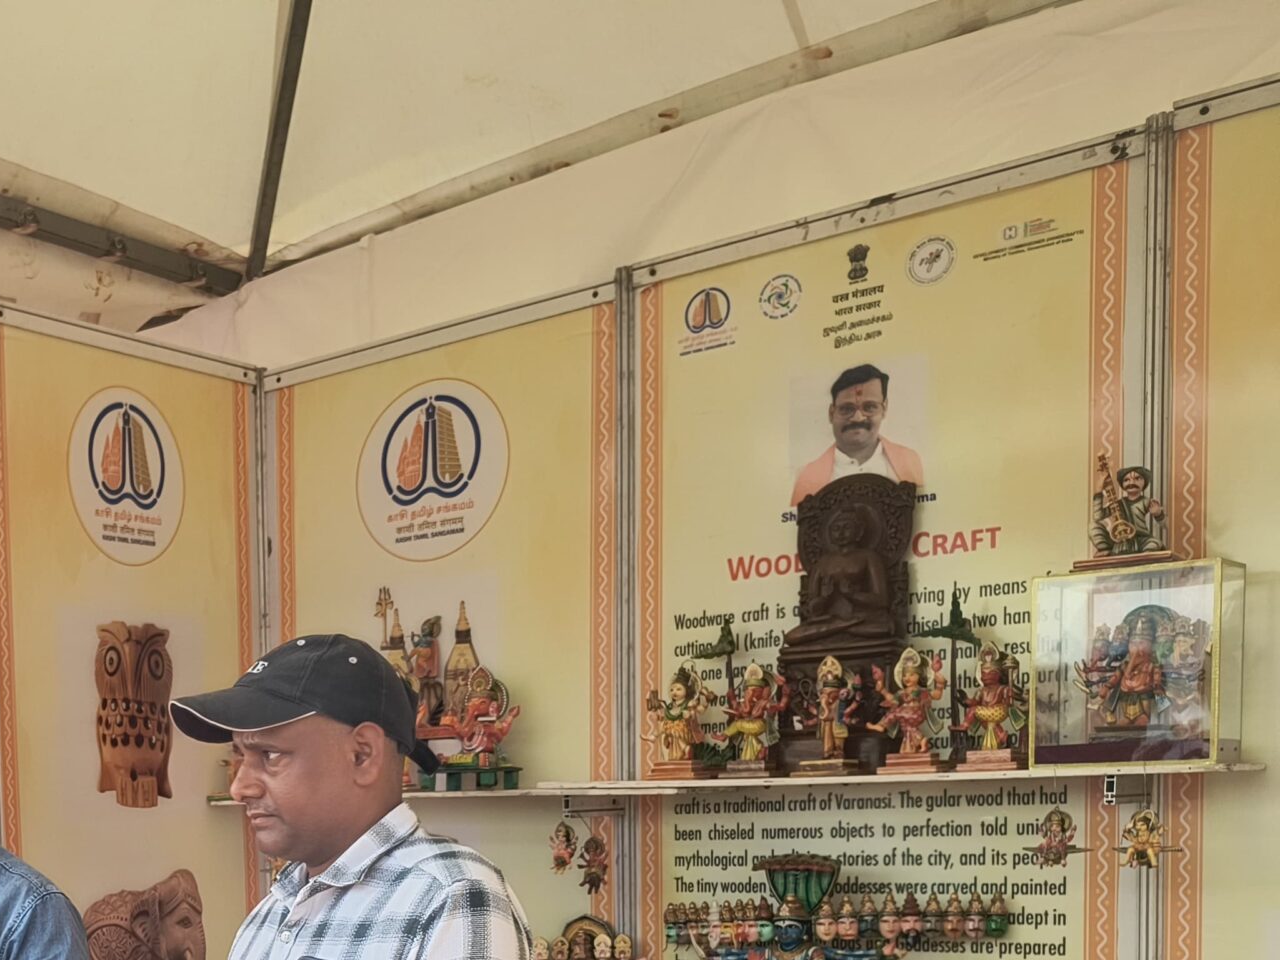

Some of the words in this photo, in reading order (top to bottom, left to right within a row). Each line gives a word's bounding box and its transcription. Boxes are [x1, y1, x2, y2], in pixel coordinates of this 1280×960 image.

[912, 526, 1001, 558] CRAFT
[674, 797, 700, 814] craft
[702, 798, 711, 814] is
[714, 801, 721, 813] a
[723, 795, 785, 813] traditional
[788, 793, 816, 811] craft
[819, 791, 832, 810] of
[835, 791, 895, 811] Varanasi.
[899, 790, 922, 808] The
[926, 788, 962, 812] gular
[965, 787, 1003, 806] wood
[1007, 786, 1036, 805] that
[1039, 785, 1067, 804] had
[674, 824, 701, 841] been
[708, 822, 754, 840] chiseled
[761, 826, 823, 839] numerous
[830, 819, 874, 842] objects
[882, 823, 895, 837] to
[902, 818, 972, 841] perfection
[980, 816, 1008, 835] told
[674, 849, 747, 870] mythological
[837, 850, 879, 867] stories
[883, 848, 897, 866] of
[901, 848, 922, 865] the
[928, 850, 954, 870] city,
[959, 847, 986, 865] and
[991, 849, 1007, 865] its
[674, 876, 693, 892] The
[696, 878, 718, 896] tiny
[720, 876, 766, 893] wooden
[895, 882, 927, 894] were
[931, 876, 977, 895] carved
[981, 876, 1007, 895] and
[1011, 876, 1066, 899] painted
